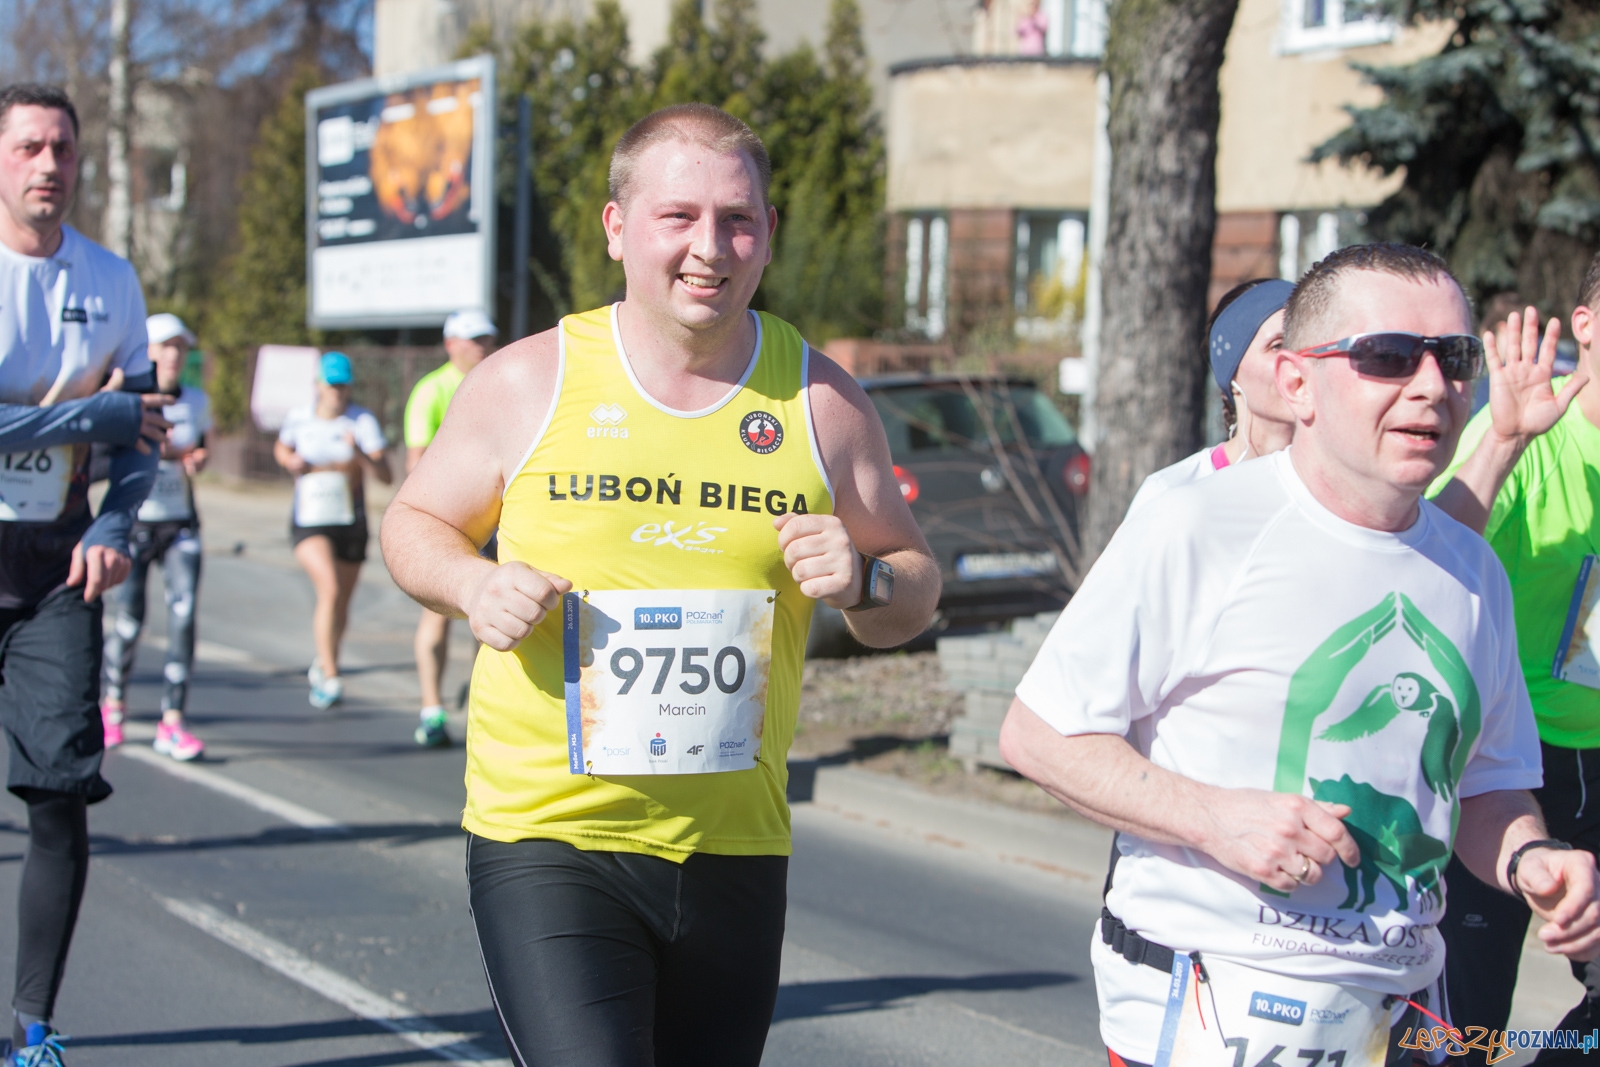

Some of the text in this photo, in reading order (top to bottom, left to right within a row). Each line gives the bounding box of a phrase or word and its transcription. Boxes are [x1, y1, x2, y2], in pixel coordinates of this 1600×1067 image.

[587, 427, 629, 439] errea
[741, 429, 782, 454] KLUB BIEGACZA
[549, 473, 808, 517] LUBOŃ BIEGA
[638, 613, 679, 624] 10. PKO
[610, 646, 746, 695] 9750
[659, 703, 706, 716] Marcin
[1256, 904, 1372, 944] DZIKA
[1171, 961, 1184, 999] 26.03.2017
[1255, 998, 1301, 1019] 10. PKO
